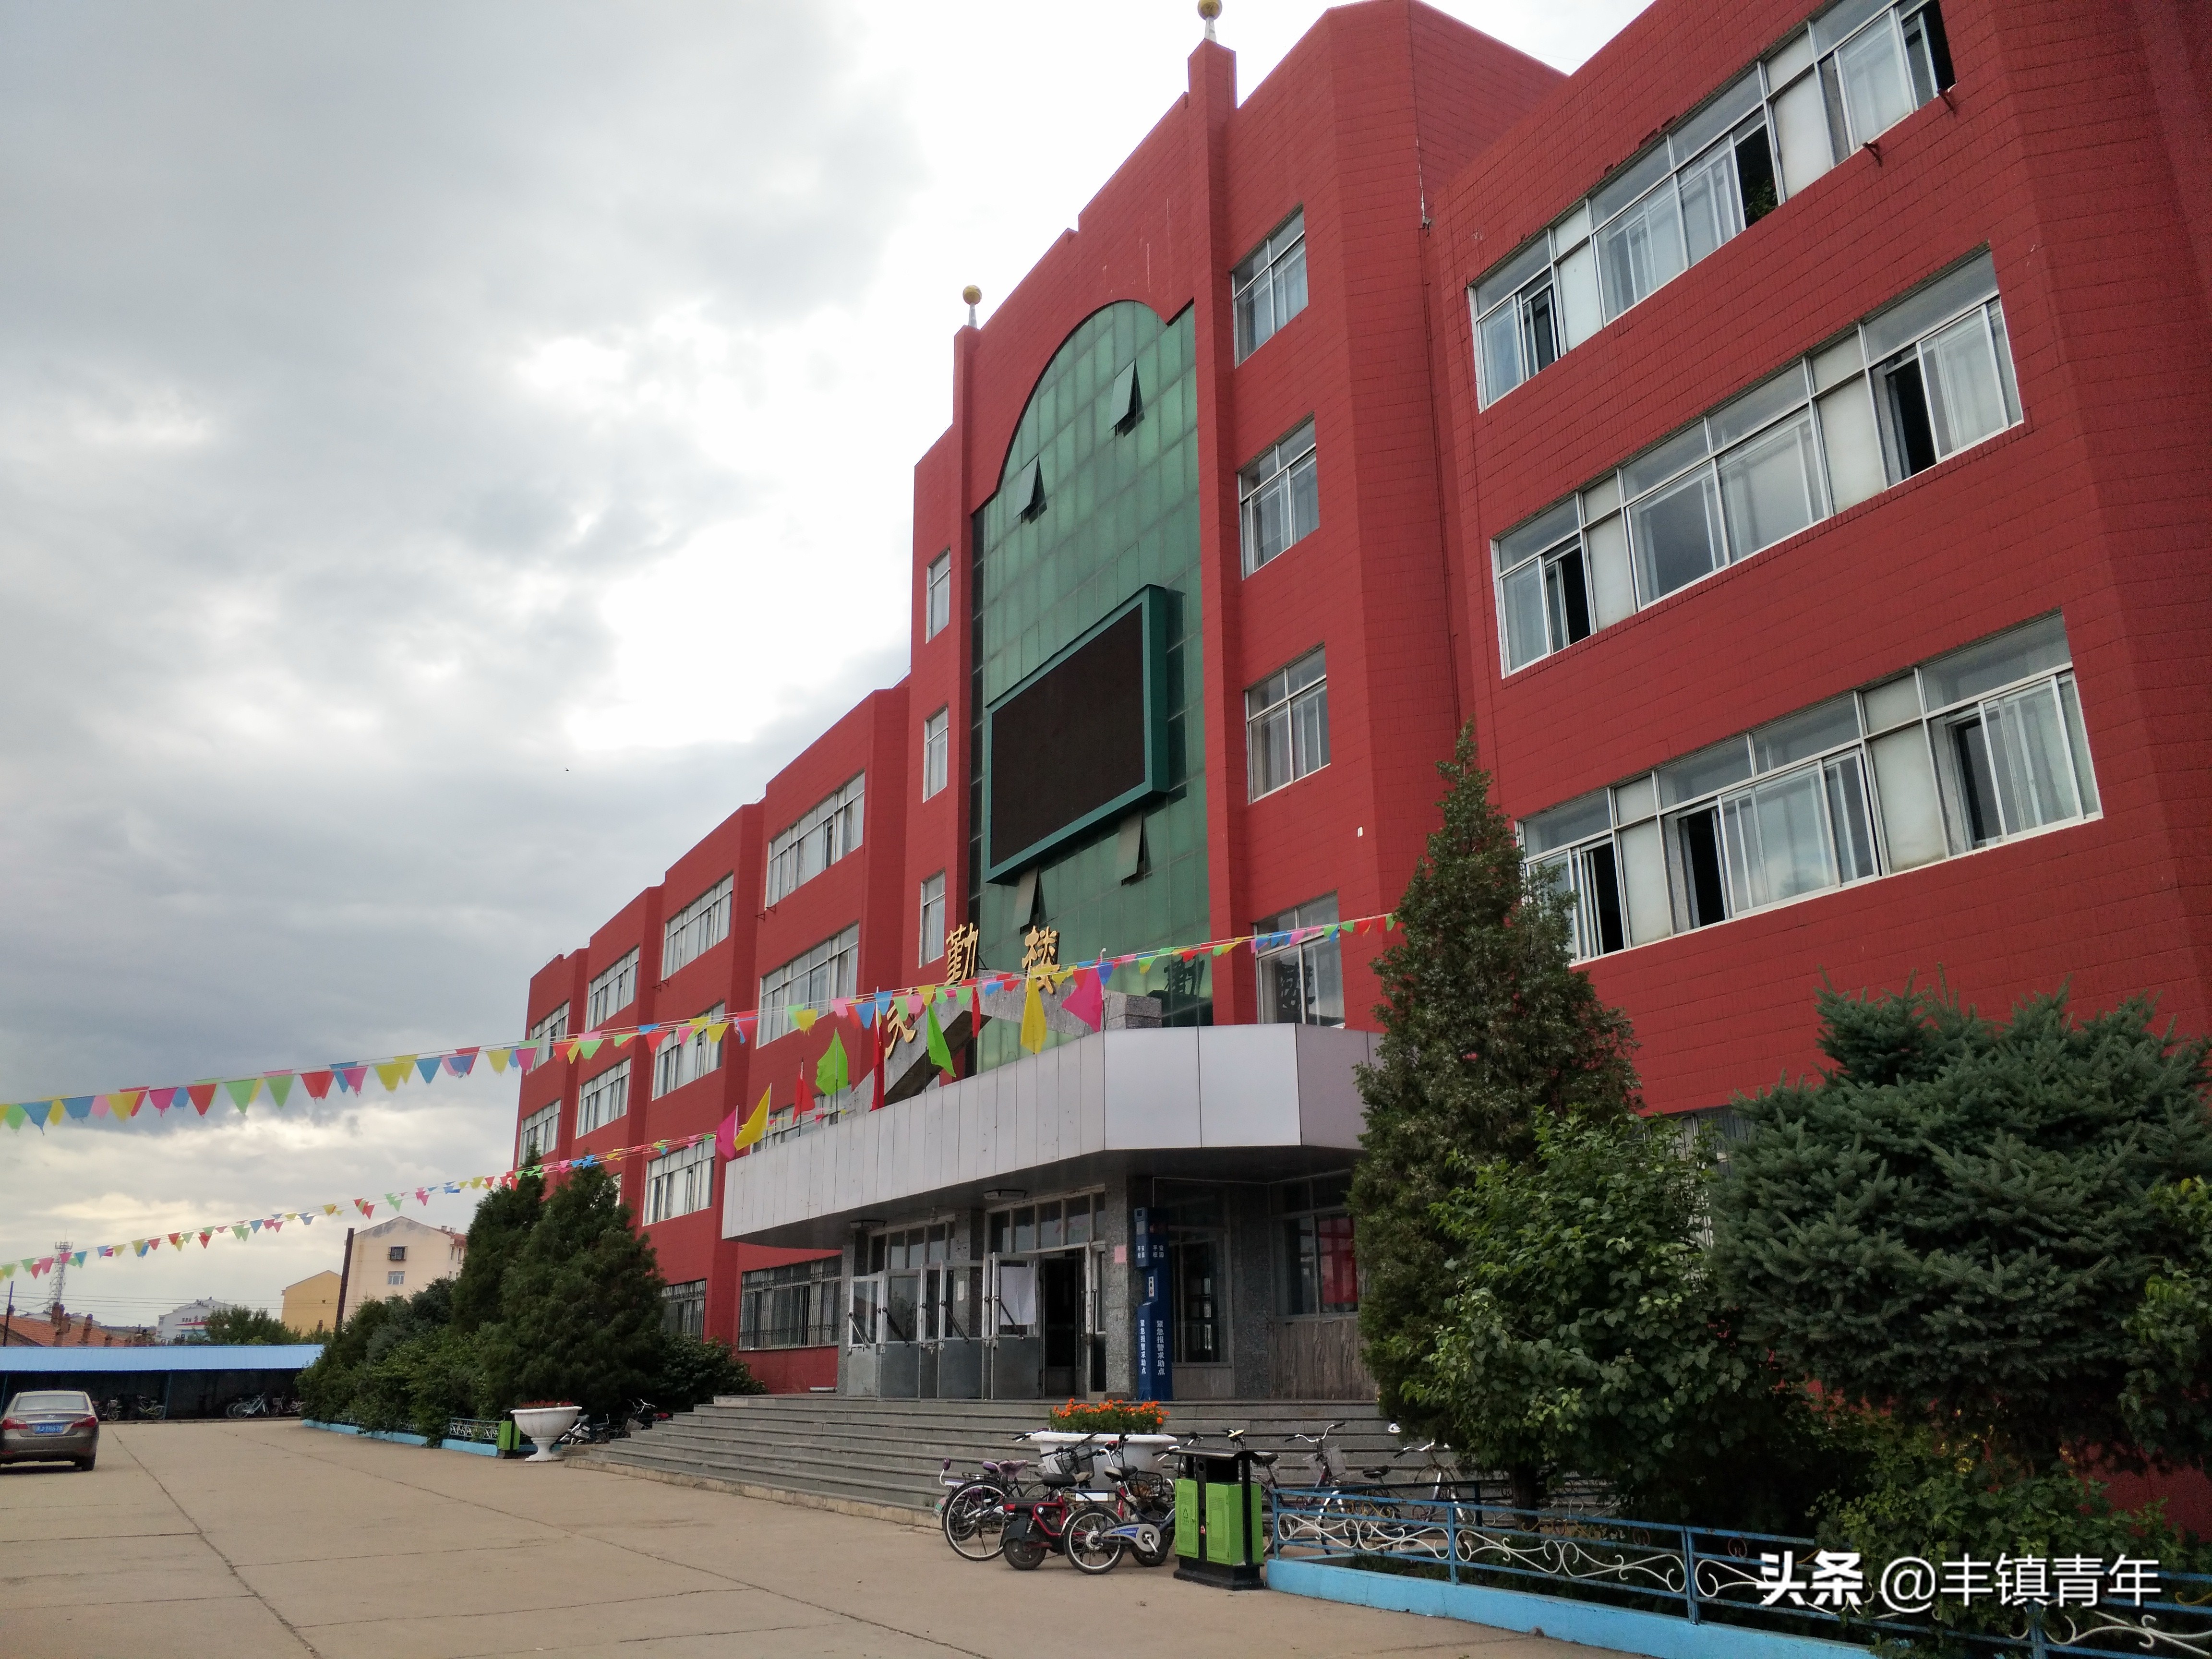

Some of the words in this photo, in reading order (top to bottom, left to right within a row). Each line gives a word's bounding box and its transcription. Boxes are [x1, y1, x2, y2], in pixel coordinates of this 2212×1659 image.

[1156, 1320, 1165, 1375] 紧急报警求助点
